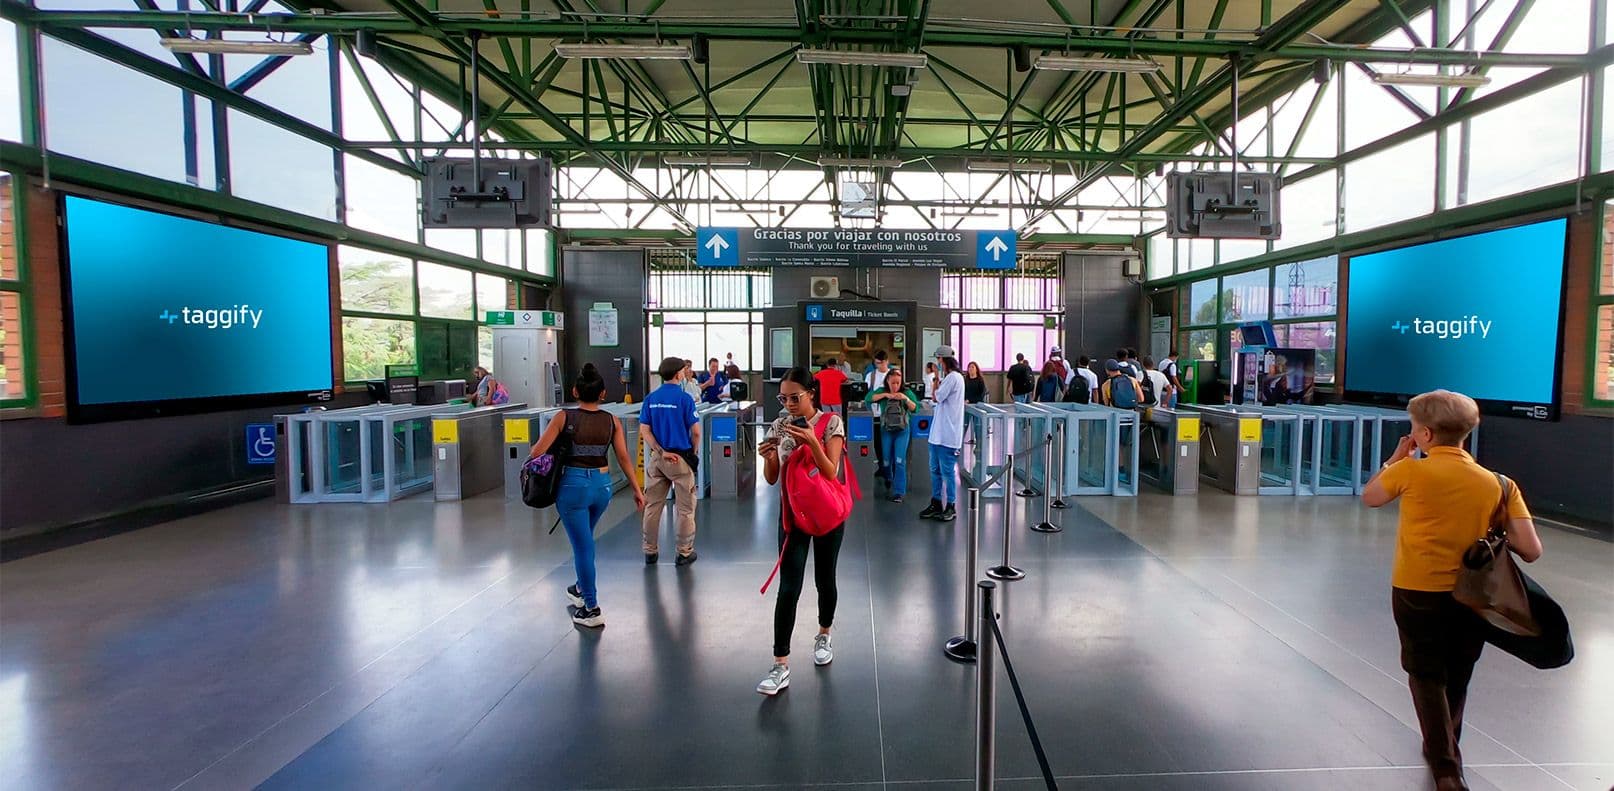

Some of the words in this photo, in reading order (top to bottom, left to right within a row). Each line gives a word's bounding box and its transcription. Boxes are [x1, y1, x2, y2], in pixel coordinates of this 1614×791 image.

[753, 228, 802, 240] Gracias
[807, 231, 829, 242] por
[834, 229, 872, 243] viajar
[877, 231, 899, 241] con
[904, 231, 962, 242] nosotros
[788, 241, 814, 250] Thank
[817, 242, 833, 251] you
[836, 241, 850, 250] for
[853, 242, 893, 252] traveling
[895, 242, 915, 251] with
[917, 243, 928, 251] us
[182, 304, 263, 329] taggify
[830, 309, 862, 318] Taquilla
[1413, 315, 1492, 339] taggify
